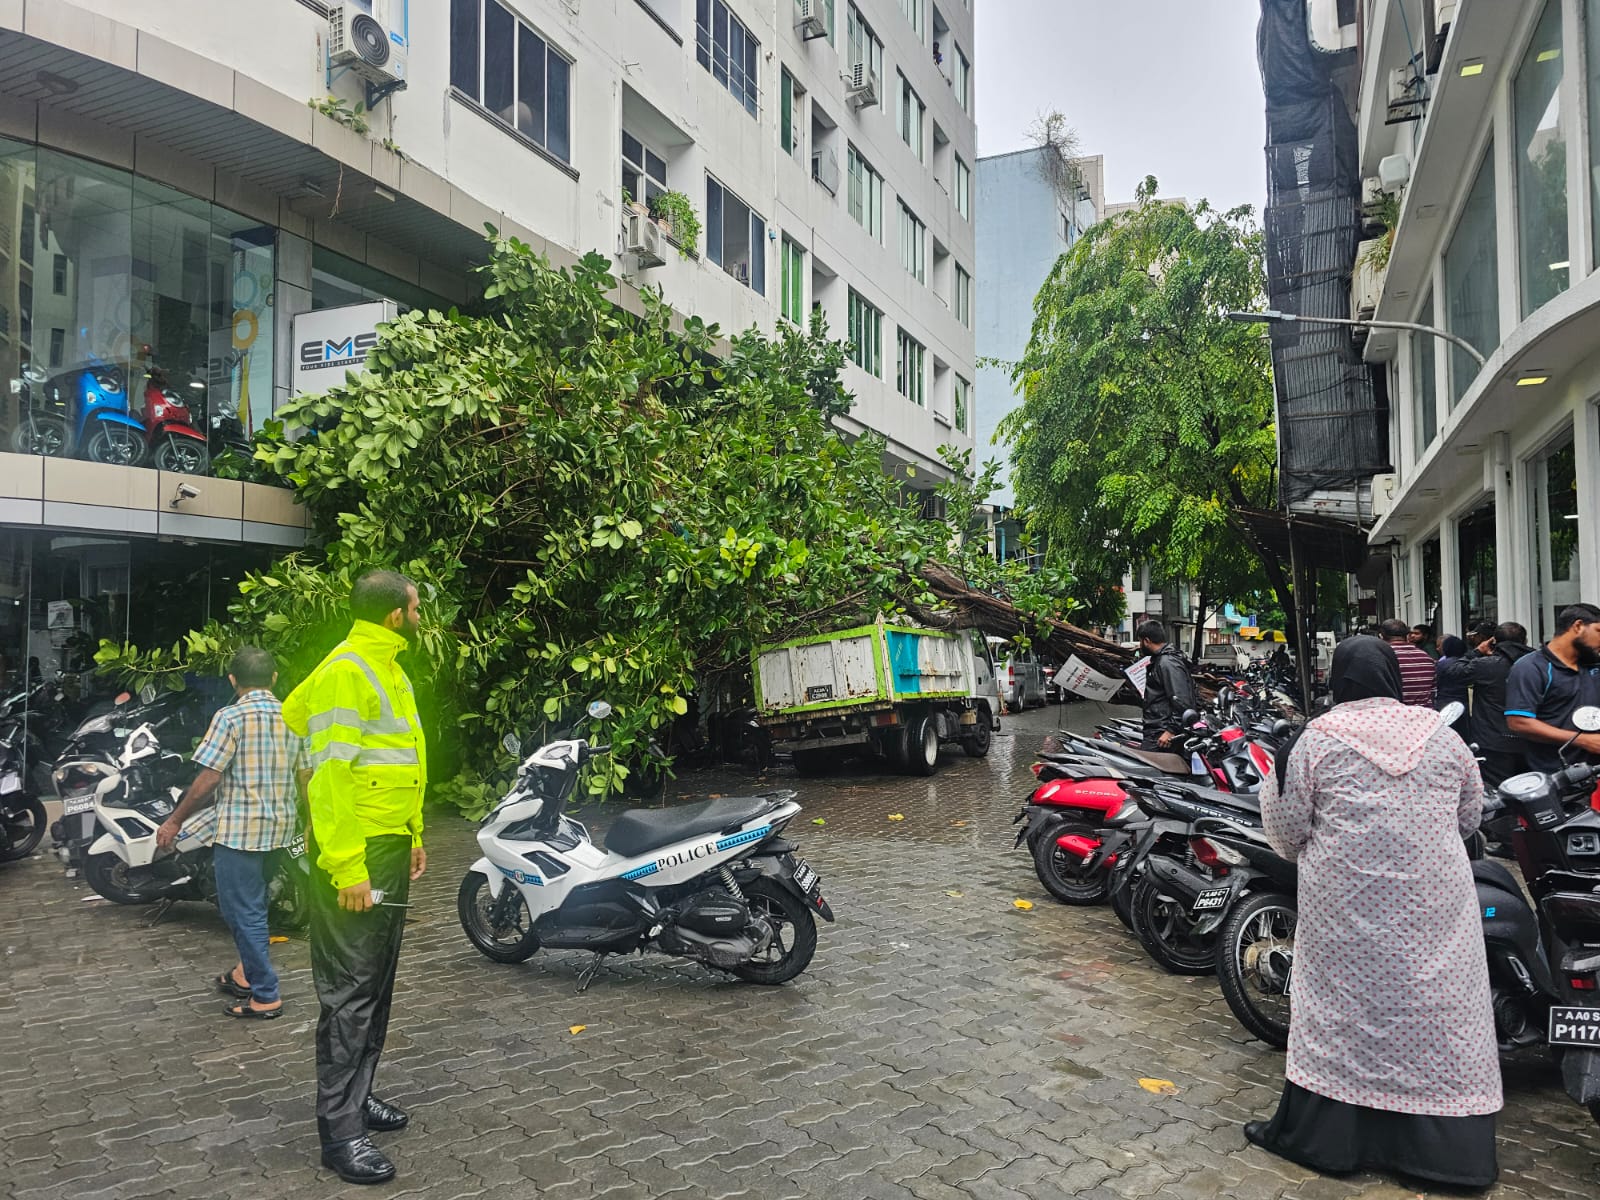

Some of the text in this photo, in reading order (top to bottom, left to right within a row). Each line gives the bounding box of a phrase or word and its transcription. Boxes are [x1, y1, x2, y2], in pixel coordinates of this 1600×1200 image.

[301, 332, 377, 362] EMS
[656, 841, 718, 872] POLICE
[1197, 897, 1223, 907] P6431
